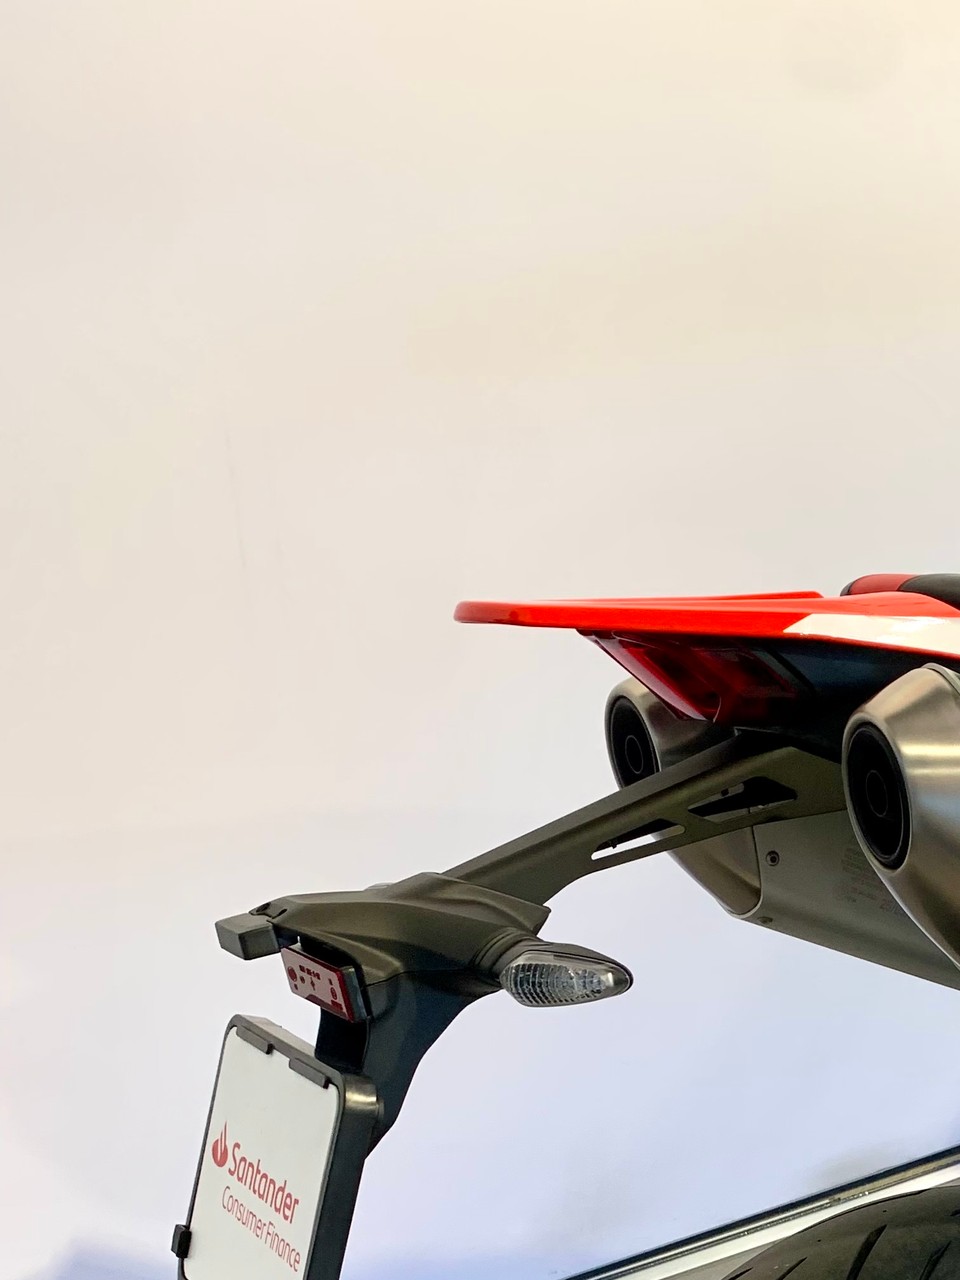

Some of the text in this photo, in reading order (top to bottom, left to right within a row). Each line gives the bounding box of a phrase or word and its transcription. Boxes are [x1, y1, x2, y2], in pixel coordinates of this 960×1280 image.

[228, 1142, 300, 1224] Santander
[222, 1186, 301, 1273] Consumer Finance
